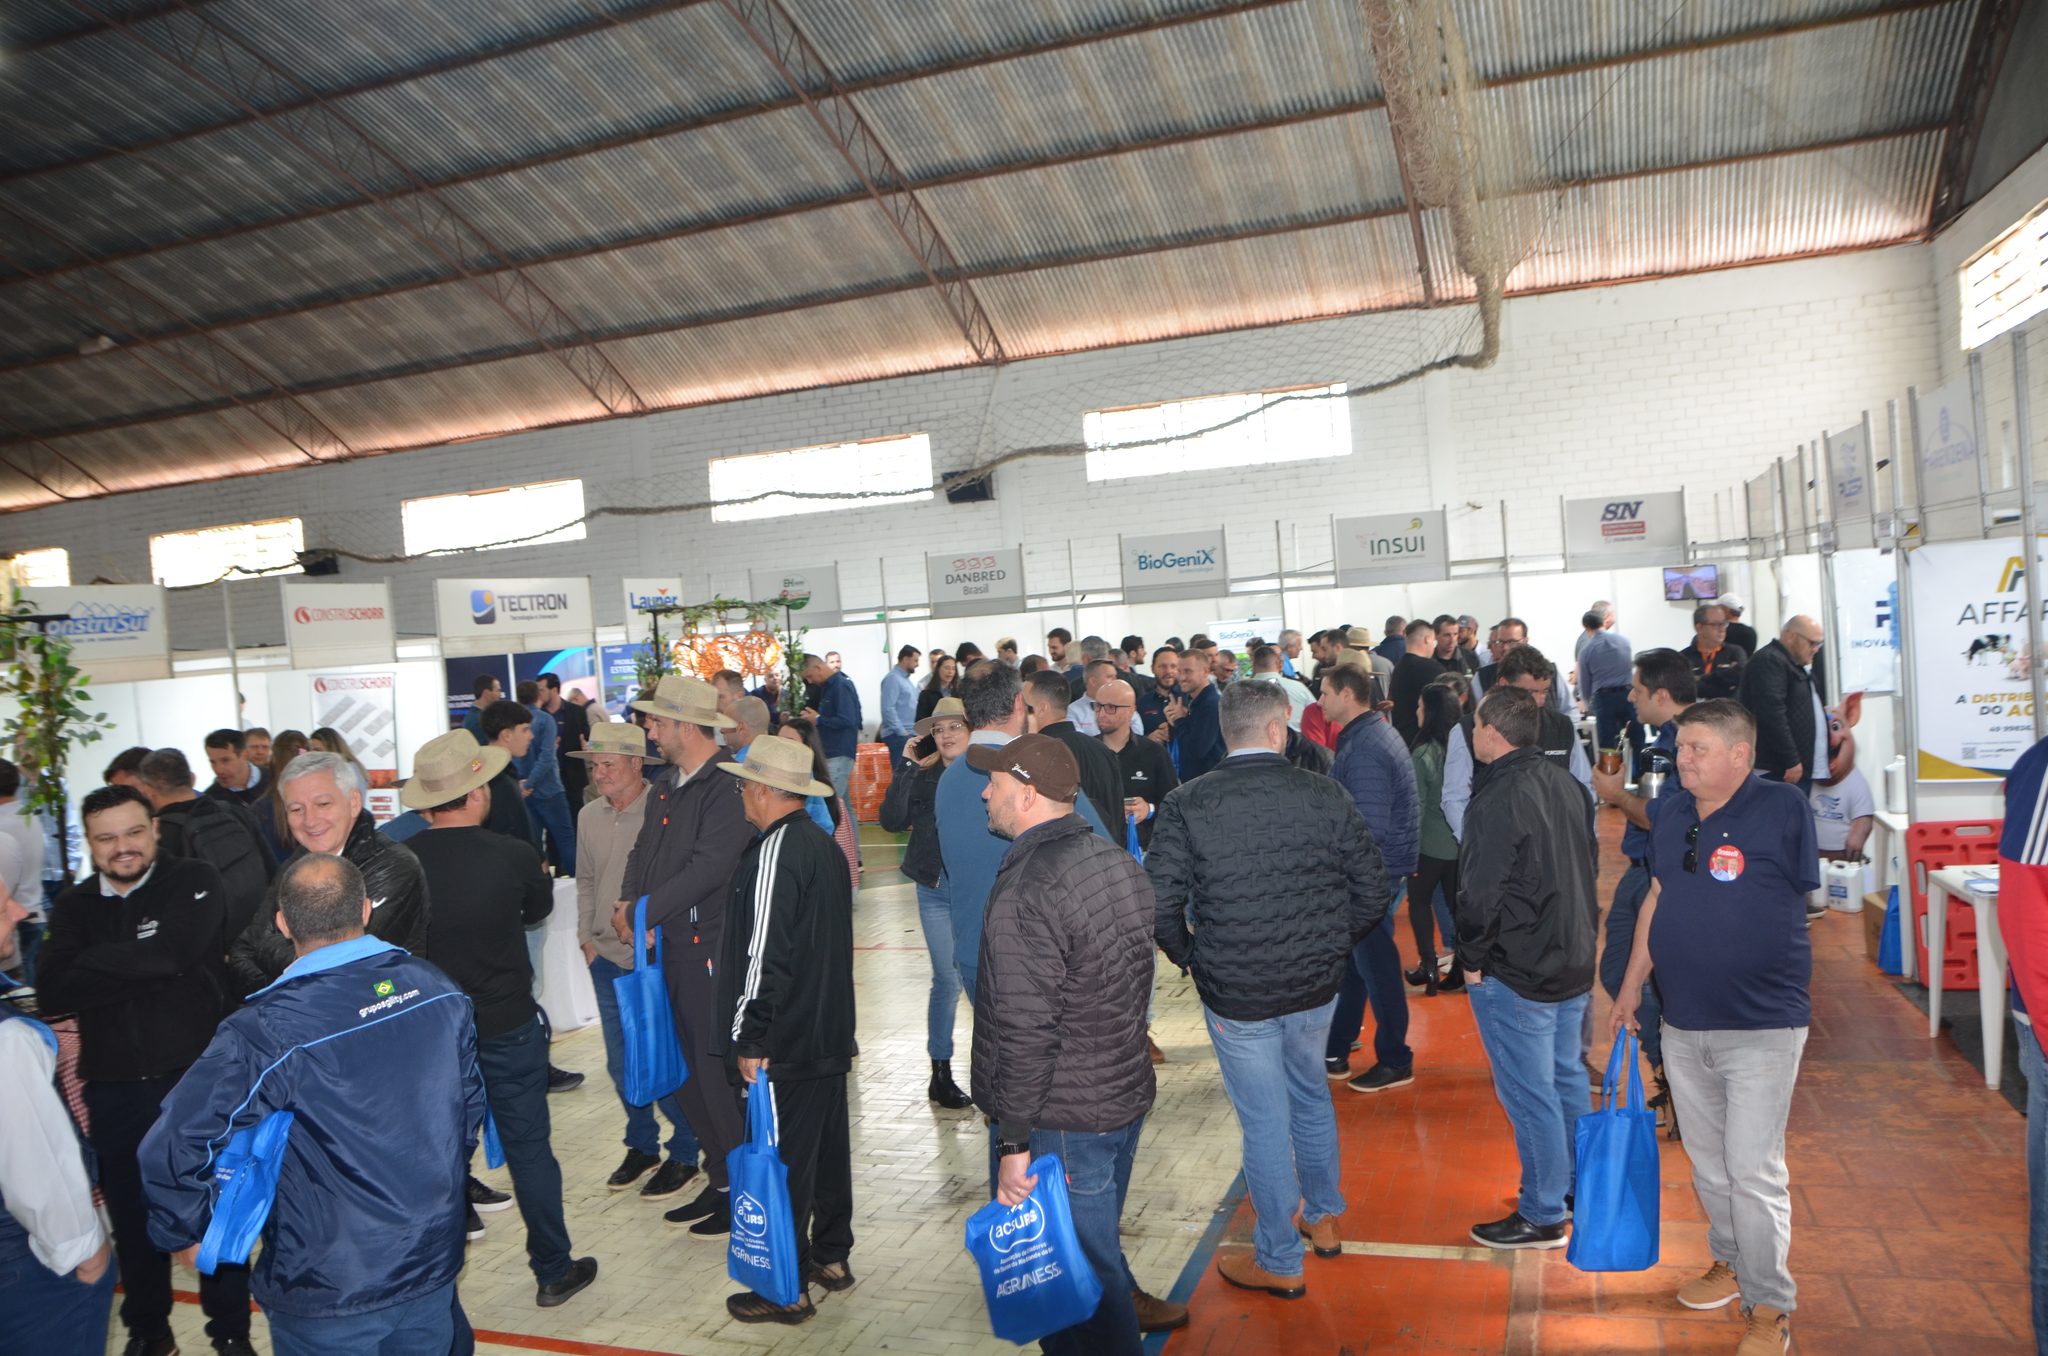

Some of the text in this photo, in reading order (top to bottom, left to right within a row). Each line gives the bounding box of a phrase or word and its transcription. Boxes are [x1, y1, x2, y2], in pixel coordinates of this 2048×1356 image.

[945, 570, 1006, 584] DANBRED
[963, 584, 989, 595] Brasil
[498, 594, 568, 612] TECTRON
[1955, 695, 1967, 704] A
[1980, 705, 2003, 716] DO
